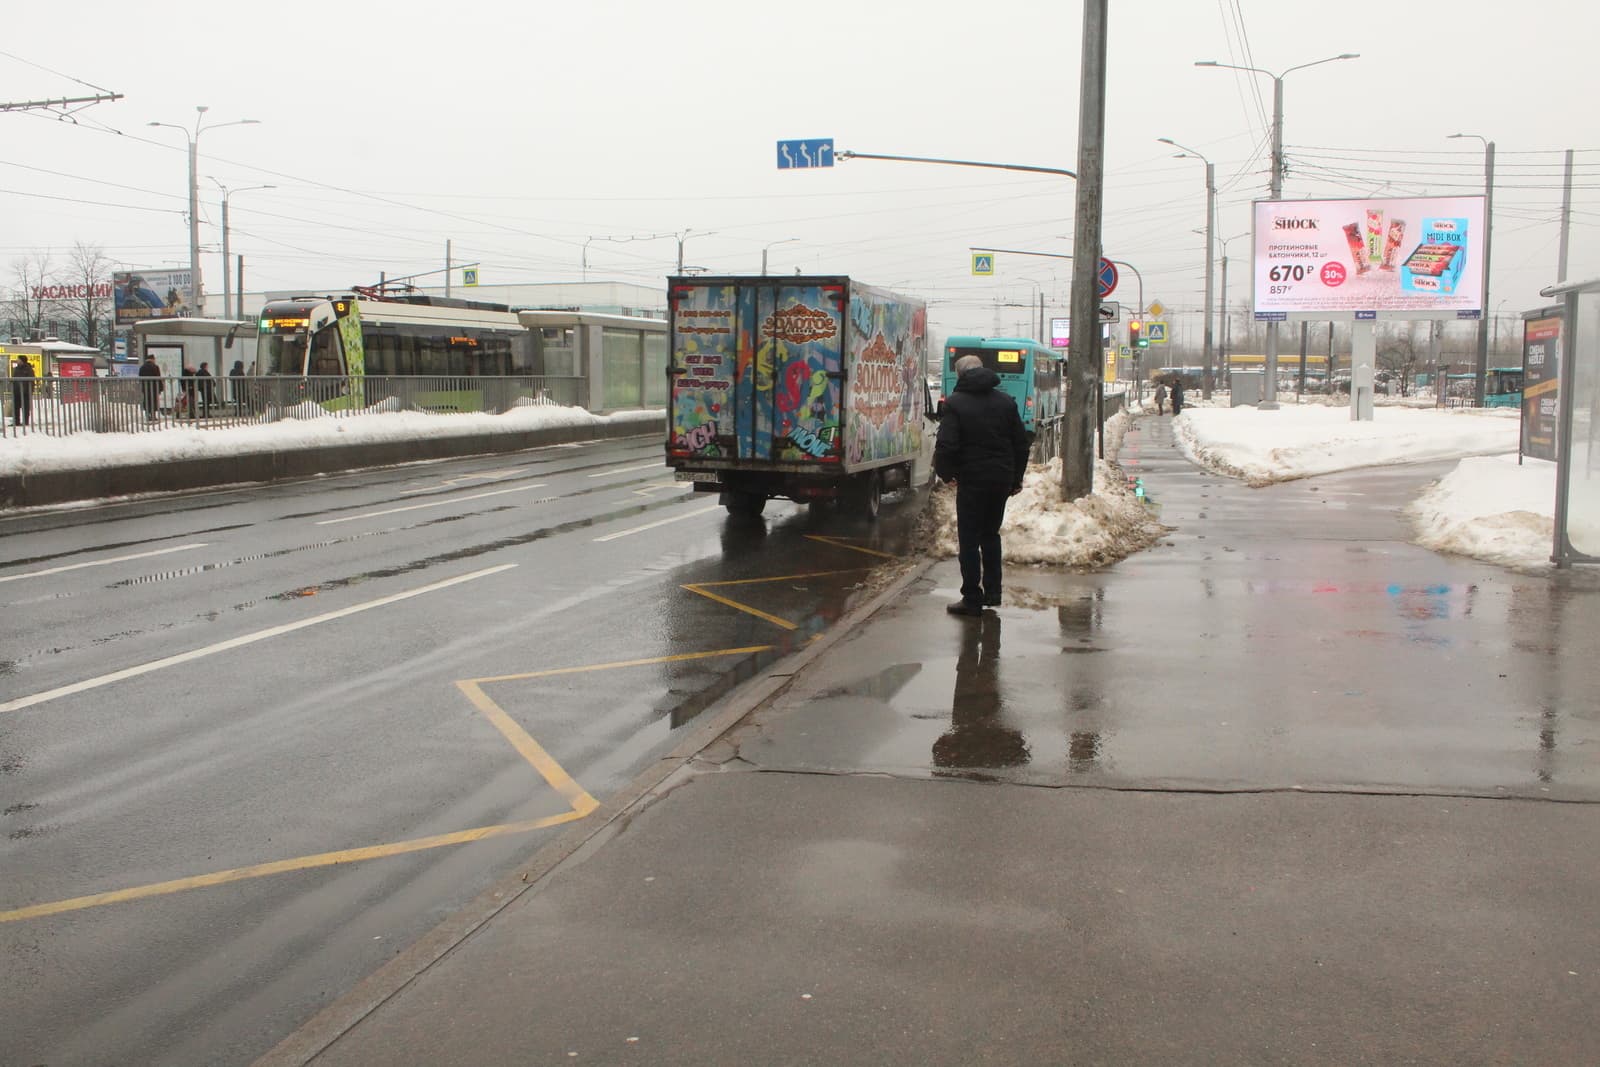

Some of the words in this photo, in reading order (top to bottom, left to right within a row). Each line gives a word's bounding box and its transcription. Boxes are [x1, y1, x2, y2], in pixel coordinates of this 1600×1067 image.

[1274, 218, 1317, 230] SHOCK
[1446, 233, 1461, 241] BOX
[1269, 264, 1305, 282] 670
[31, 279, 113, 299] ХАСАНСКИЙ
